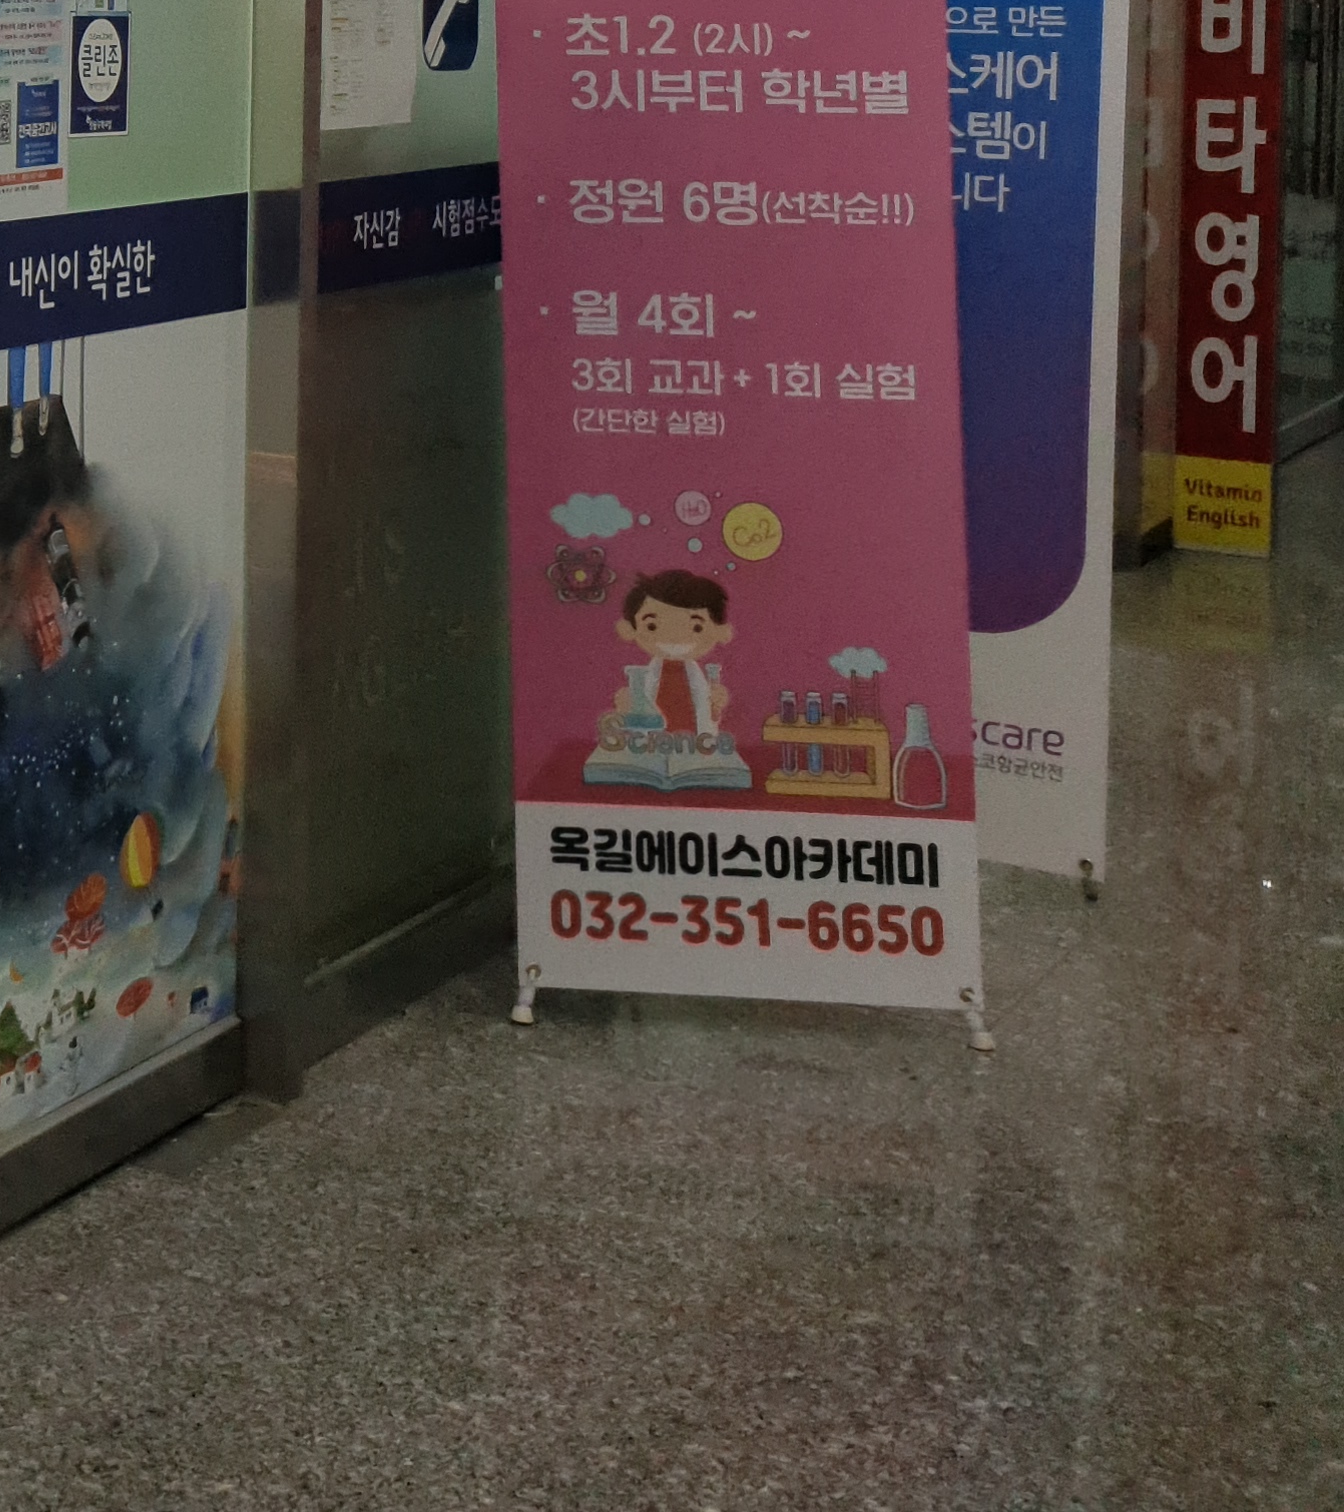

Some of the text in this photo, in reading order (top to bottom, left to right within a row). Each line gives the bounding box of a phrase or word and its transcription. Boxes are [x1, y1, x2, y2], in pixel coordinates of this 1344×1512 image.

[566, 13, 774, 57] 초1.2 (2시)
[1009, 6, 1067, 37] 만든
[81, 44, 119, 77] 클린존
[570, 67, 910, 116] 3시부터 학년별
[569, 178, 664, 225] 정원
[353, 207, 401, 250] 자신감
[9, 238, 156, 309] 내신이 확실한
[572, 290, 715, 339] 월 4회
[571, 357, 633, 395] 3회
[647, 359, 725, 396] 교과
[765, 361, 822, 398] 1회
[834, 363, 917, 401] 실험
[572, 408, 726, 437] (간단한 실험)
[1184, 478, 1263, 503] Vitamin
[1186, 504, 1260, 530] English
[549, 824, 941, 889] 옥길에이스아카데미
[549, 888, 946, 958] 032-351-6650
